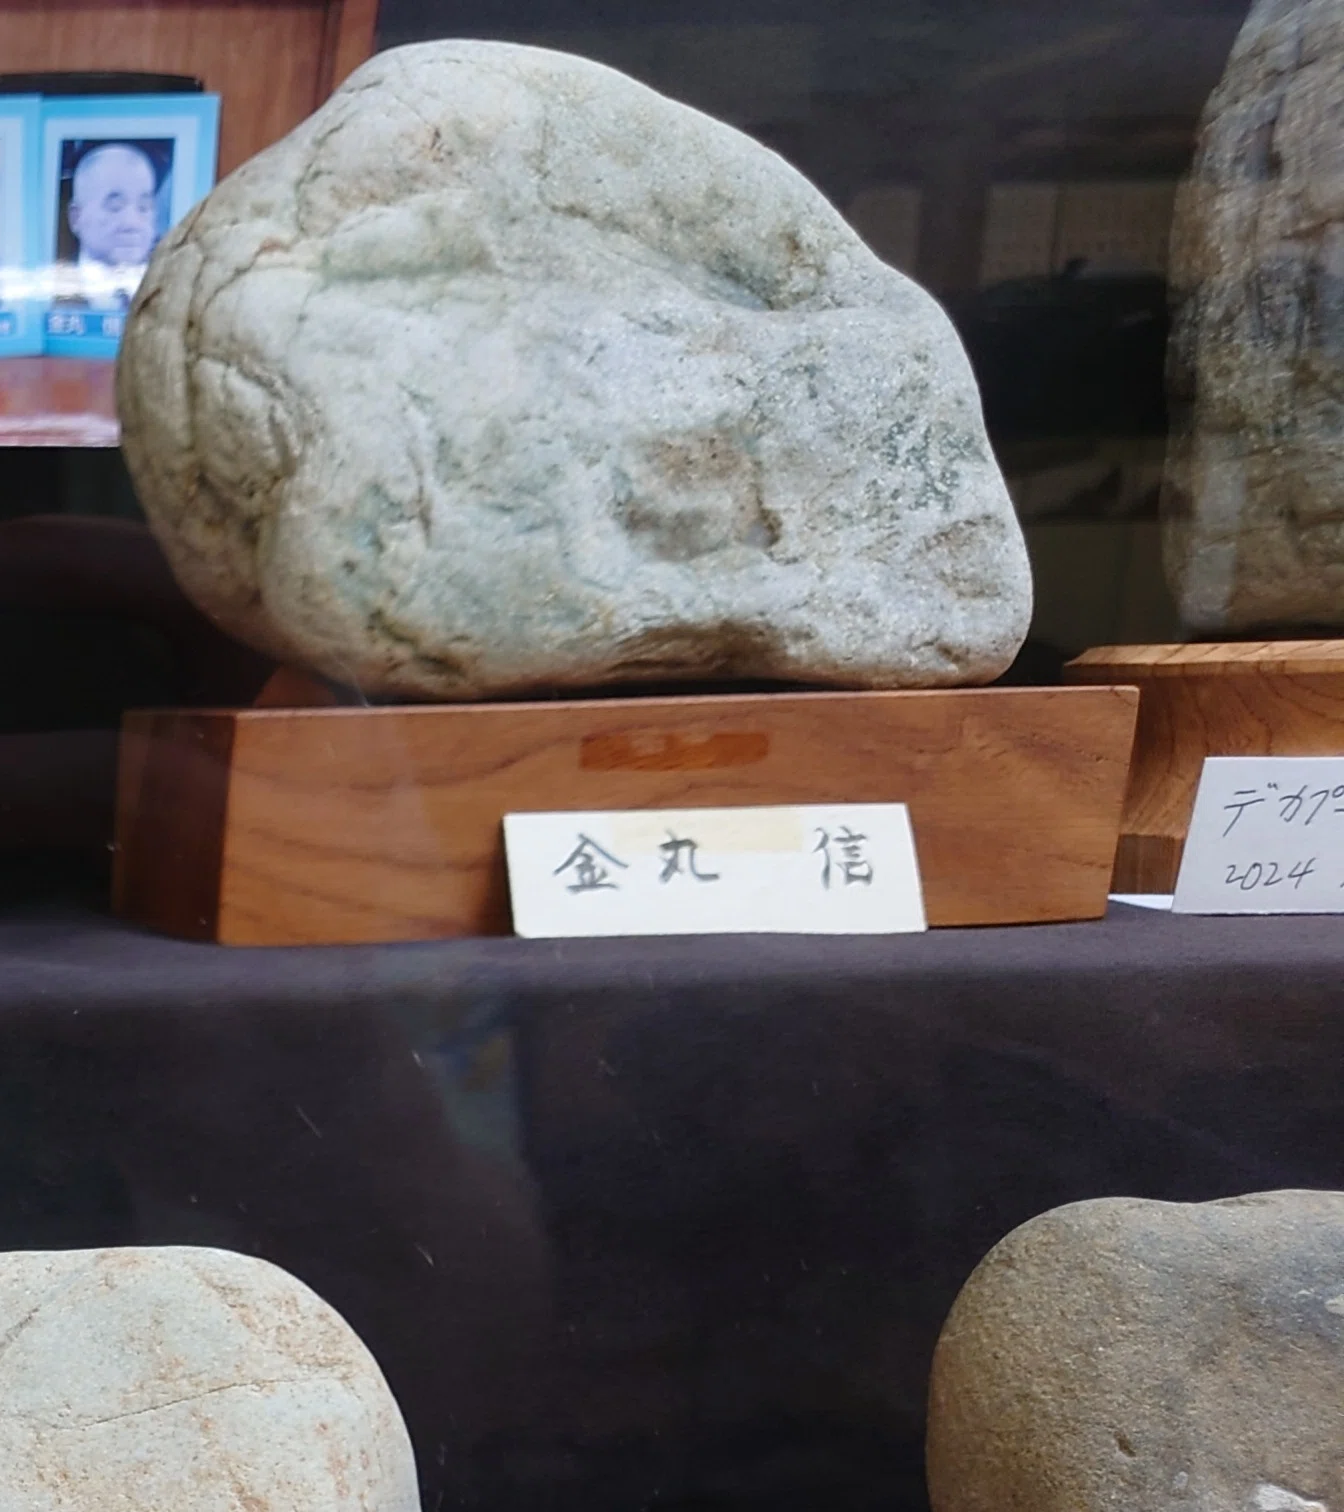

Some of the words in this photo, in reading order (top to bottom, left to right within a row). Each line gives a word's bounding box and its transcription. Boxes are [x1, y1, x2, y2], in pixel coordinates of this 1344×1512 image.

[1223, 781, 1344, 837] デカプ
[1224, 857, 1317, 890] 2024
